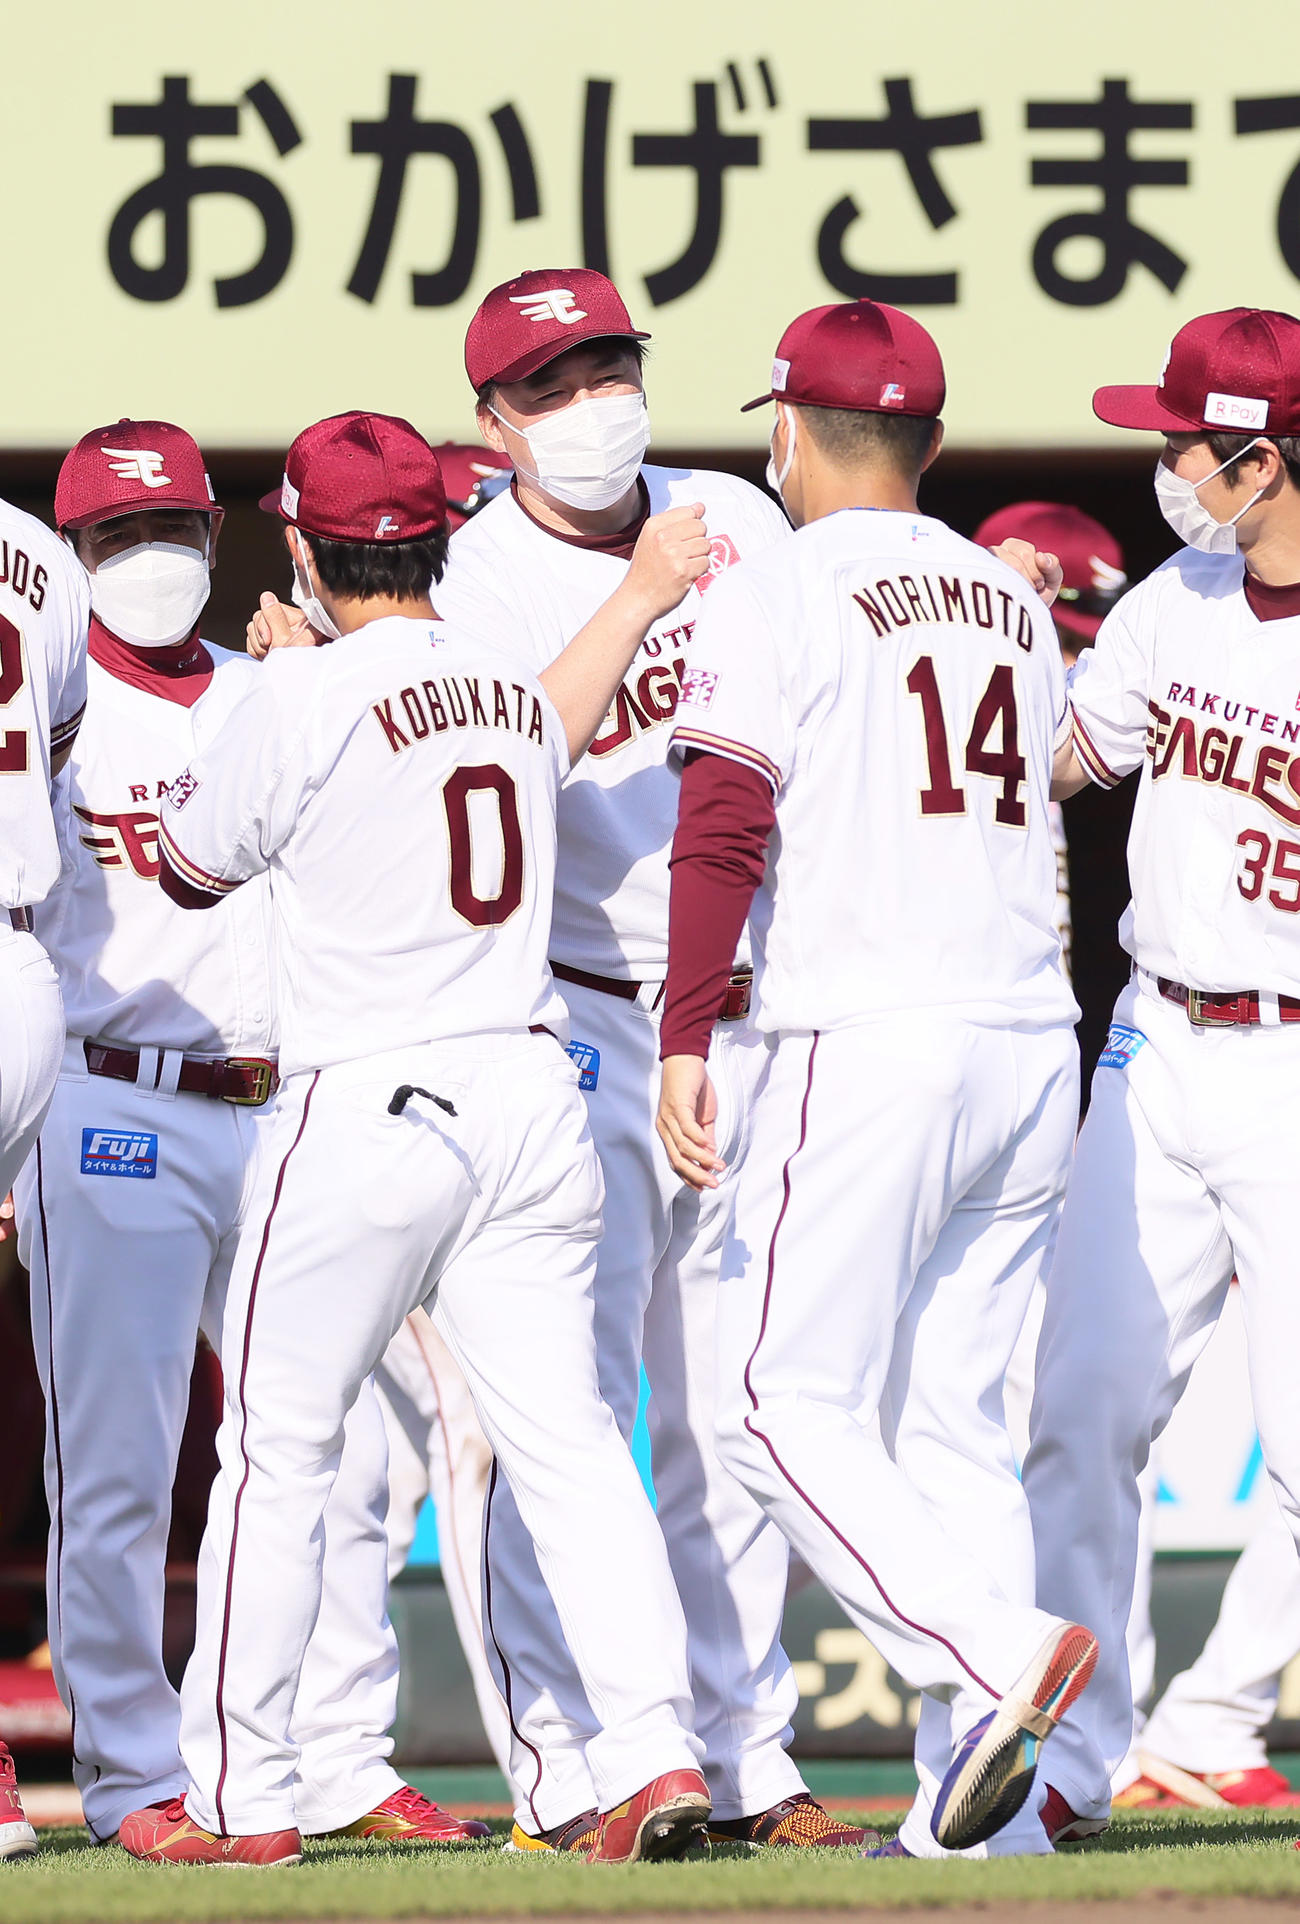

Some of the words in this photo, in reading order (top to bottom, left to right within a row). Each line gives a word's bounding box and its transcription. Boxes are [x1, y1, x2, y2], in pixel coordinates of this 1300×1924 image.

[1230, 404, 1260, 422] Pay
[851, 574, 1034, 653] NORIMOTO
[371, 675, 544, 755] KOBUKATA
[905, 654, 1028, 829] 14
[1166, 681, 1300, 744] RAKUTEN
[1235, 827, 1300, 914] 35
